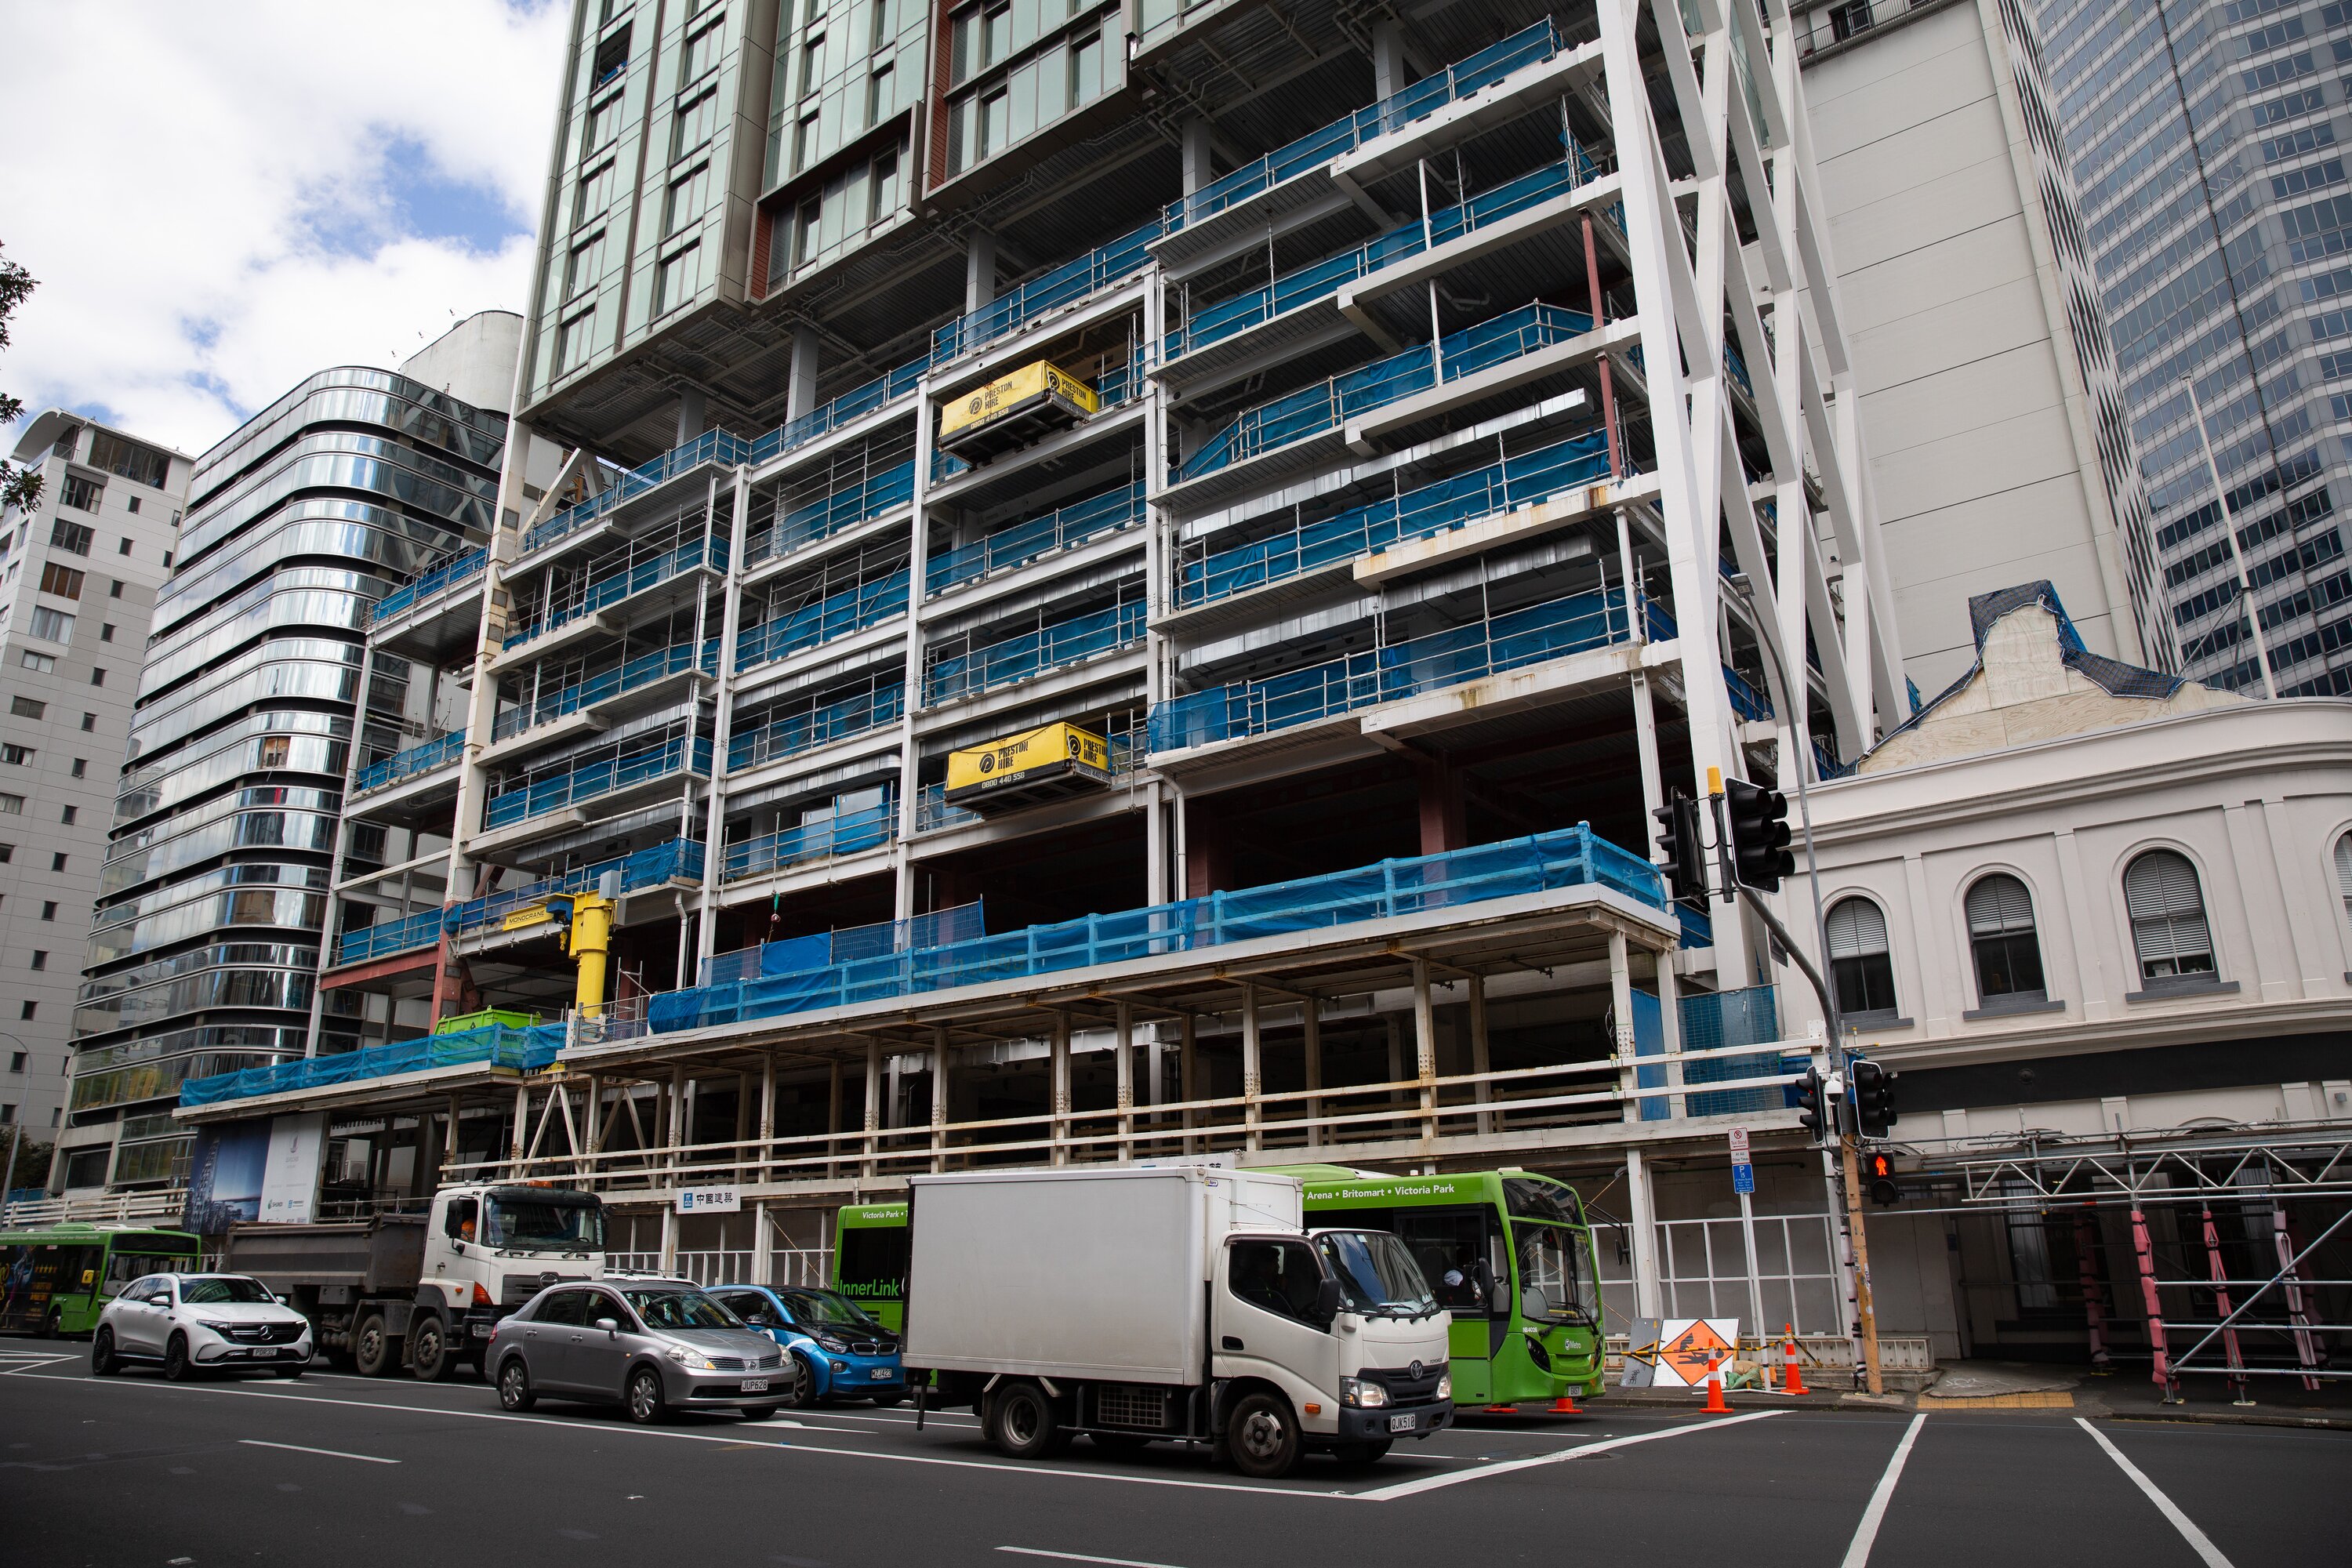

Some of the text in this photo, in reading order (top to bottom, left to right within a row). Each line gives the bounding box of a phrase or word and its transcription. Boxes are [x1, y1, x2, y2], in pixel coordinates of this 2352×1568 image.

[985, 381, 1012, 401] PRESTON
[1062, 378, 1087, 401] PRESTON
[1062, 387, 1074, 401] HIRE
[985, 397, 999, 409] HIRE
[970, 419, 985, 430] 0800
[985, 413, 997, 422] 440
[998, 740, 1029, 759] PRESTON
[1083, 750, 1098, 764] HIRE
[998, 757, 1014, 770] HIRE
[982, 771, 1025, 789] 0800 440 558
[509, 909, 545, 924] MONOCRANE
[1307, 1183, 1455, 1200] Arena Britomart Victoria Park
[839, 1278, 900, 1297] InnerLink
[1570, 1340, 1581, 1349] Metro
[872, 1369, 892, 1377] MZJ423
[742, 1380, 768, 1391] JUP628
[1392, 1415, 1416, 1430] QJK510
